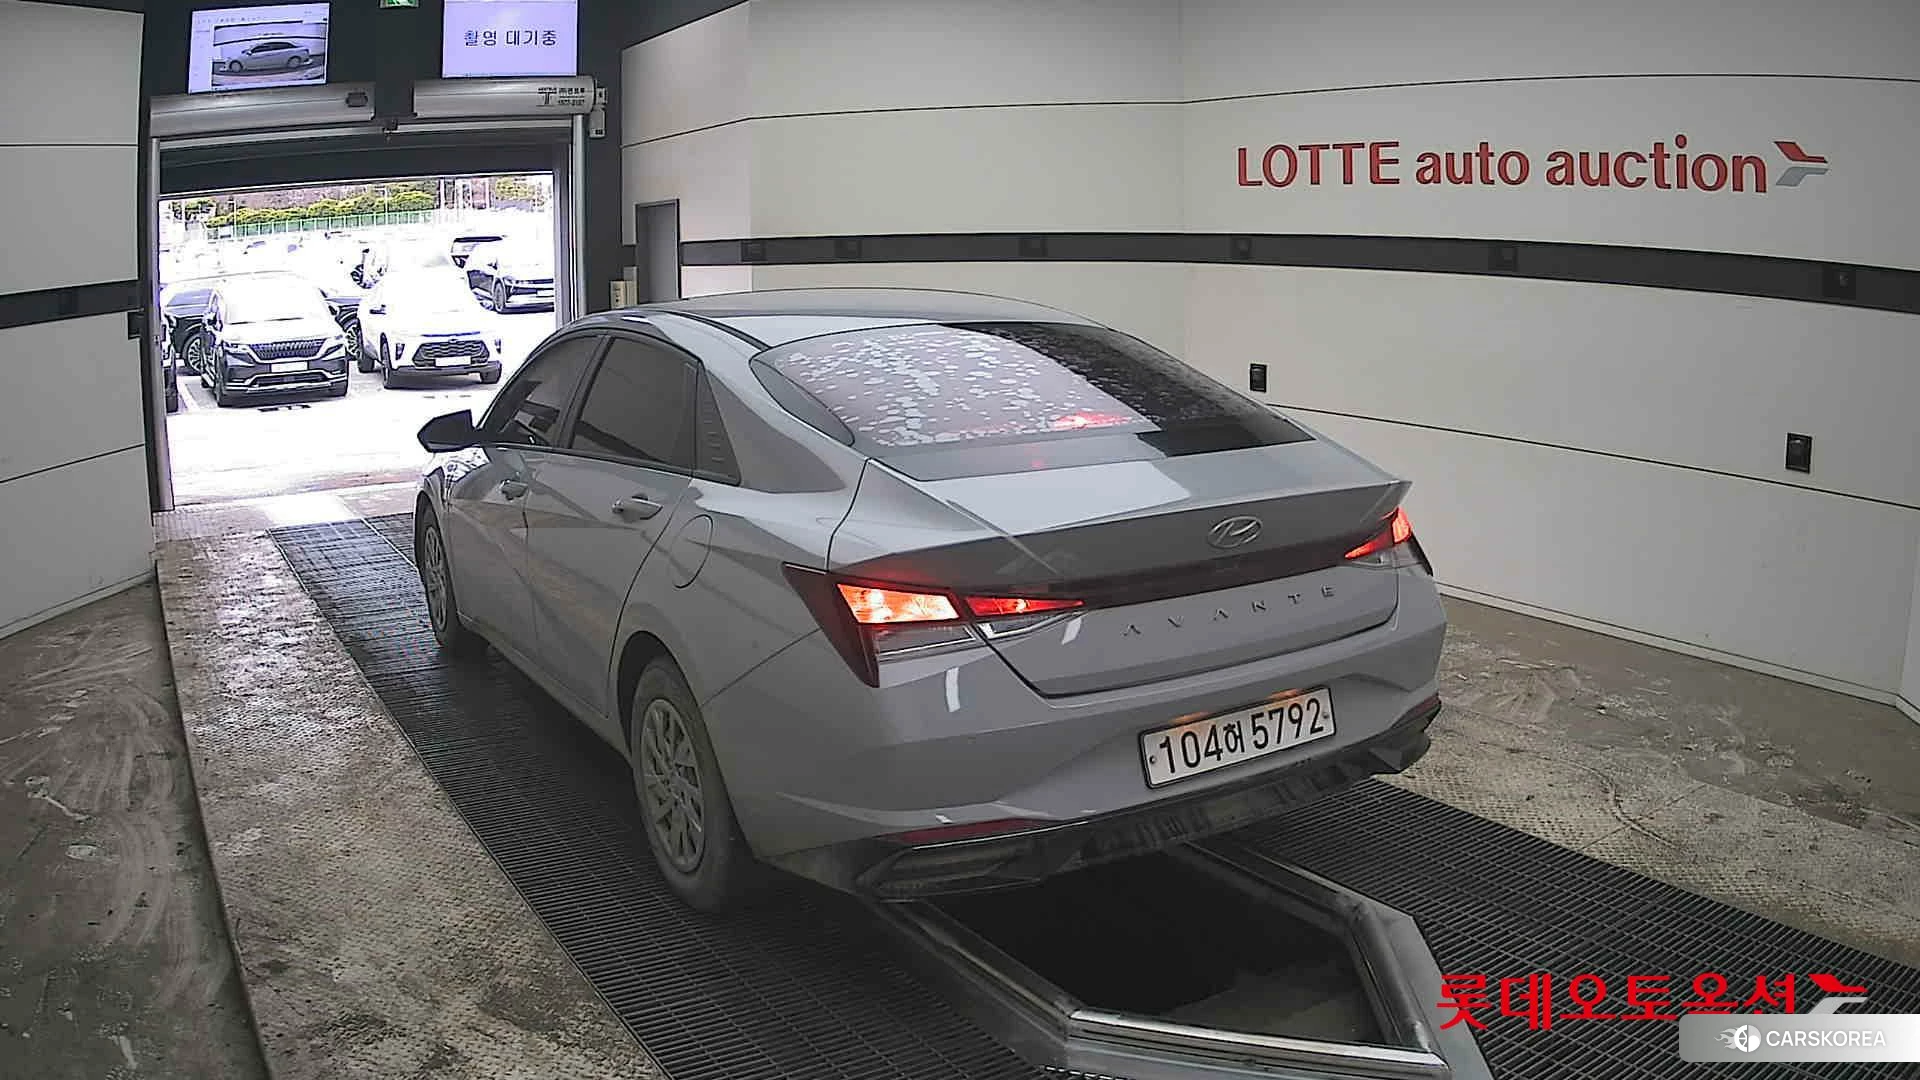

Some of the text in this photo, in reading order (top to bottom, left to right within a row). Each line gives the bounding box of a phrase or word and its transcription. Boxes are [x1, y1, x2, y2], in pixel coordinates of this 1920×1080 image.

[464, 30, 557, 46] 촬영 대기중
[1238, 134, 1767, 193] LOTTE auto auction
[1121, 583, 1335, 637] AVANTE
